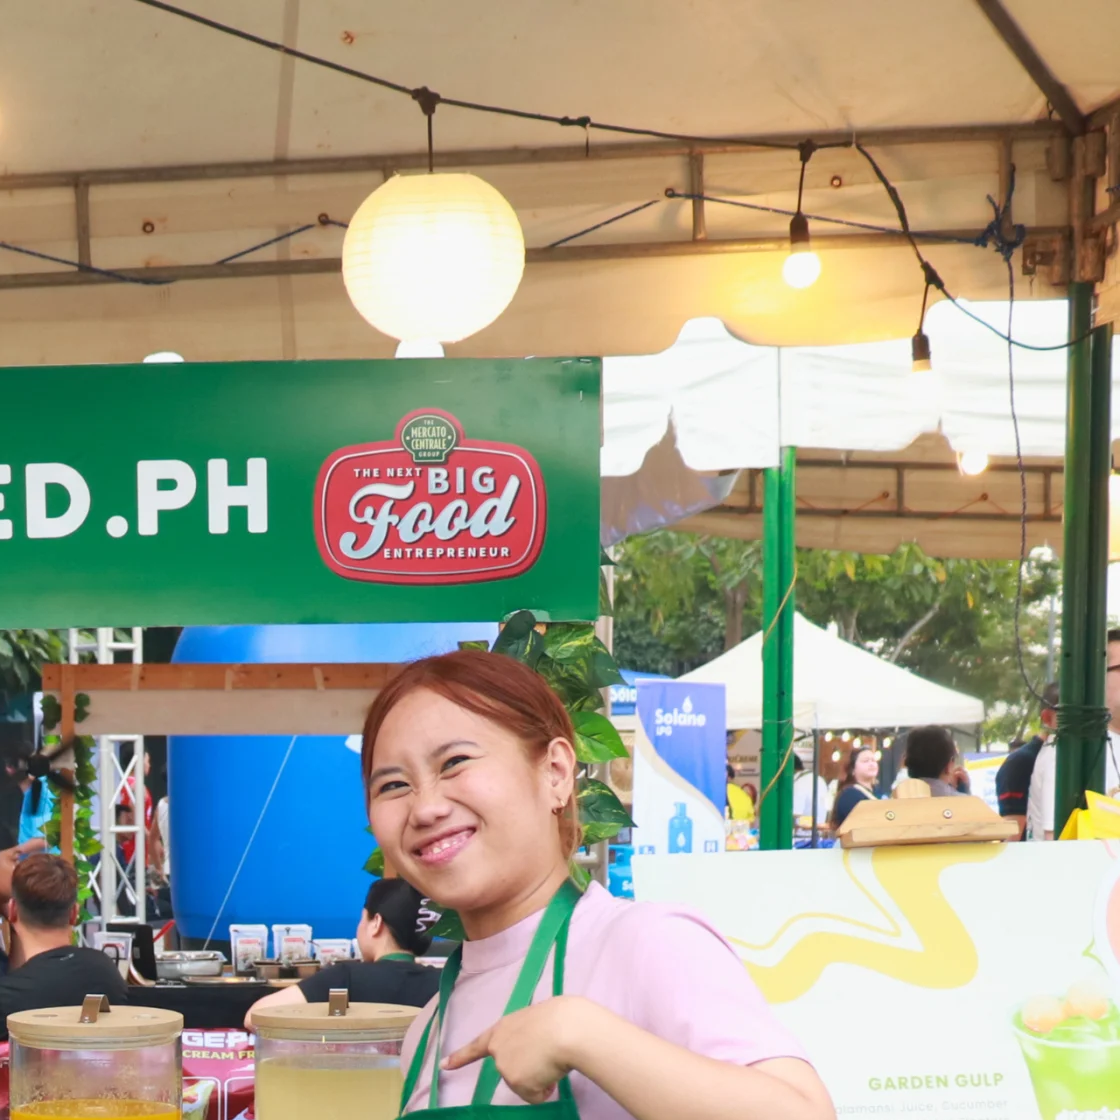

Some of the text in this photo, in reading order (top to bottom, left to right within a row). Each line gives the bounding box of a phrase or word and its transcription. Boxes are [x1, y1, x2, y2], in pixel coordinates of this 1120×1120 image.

[411, 426, 447, 438] MERCATO
[411, 438, 447, 450] CENTRALE
[353, 465, 496, 494] THE NEXT BIG
[339, 475, 521, 560] Food
[383, 547, 510, 559] ENTREPRENEUR
[655, 708, 707, 727] Solane
[182, 1049, 234, 1060] CREAM
[868, 1072, 1004, 1091] GARDEN GULP
[836, 1101, 894, 1114] alamansi
[941, 1099, 1008, 1111] Cucumber
